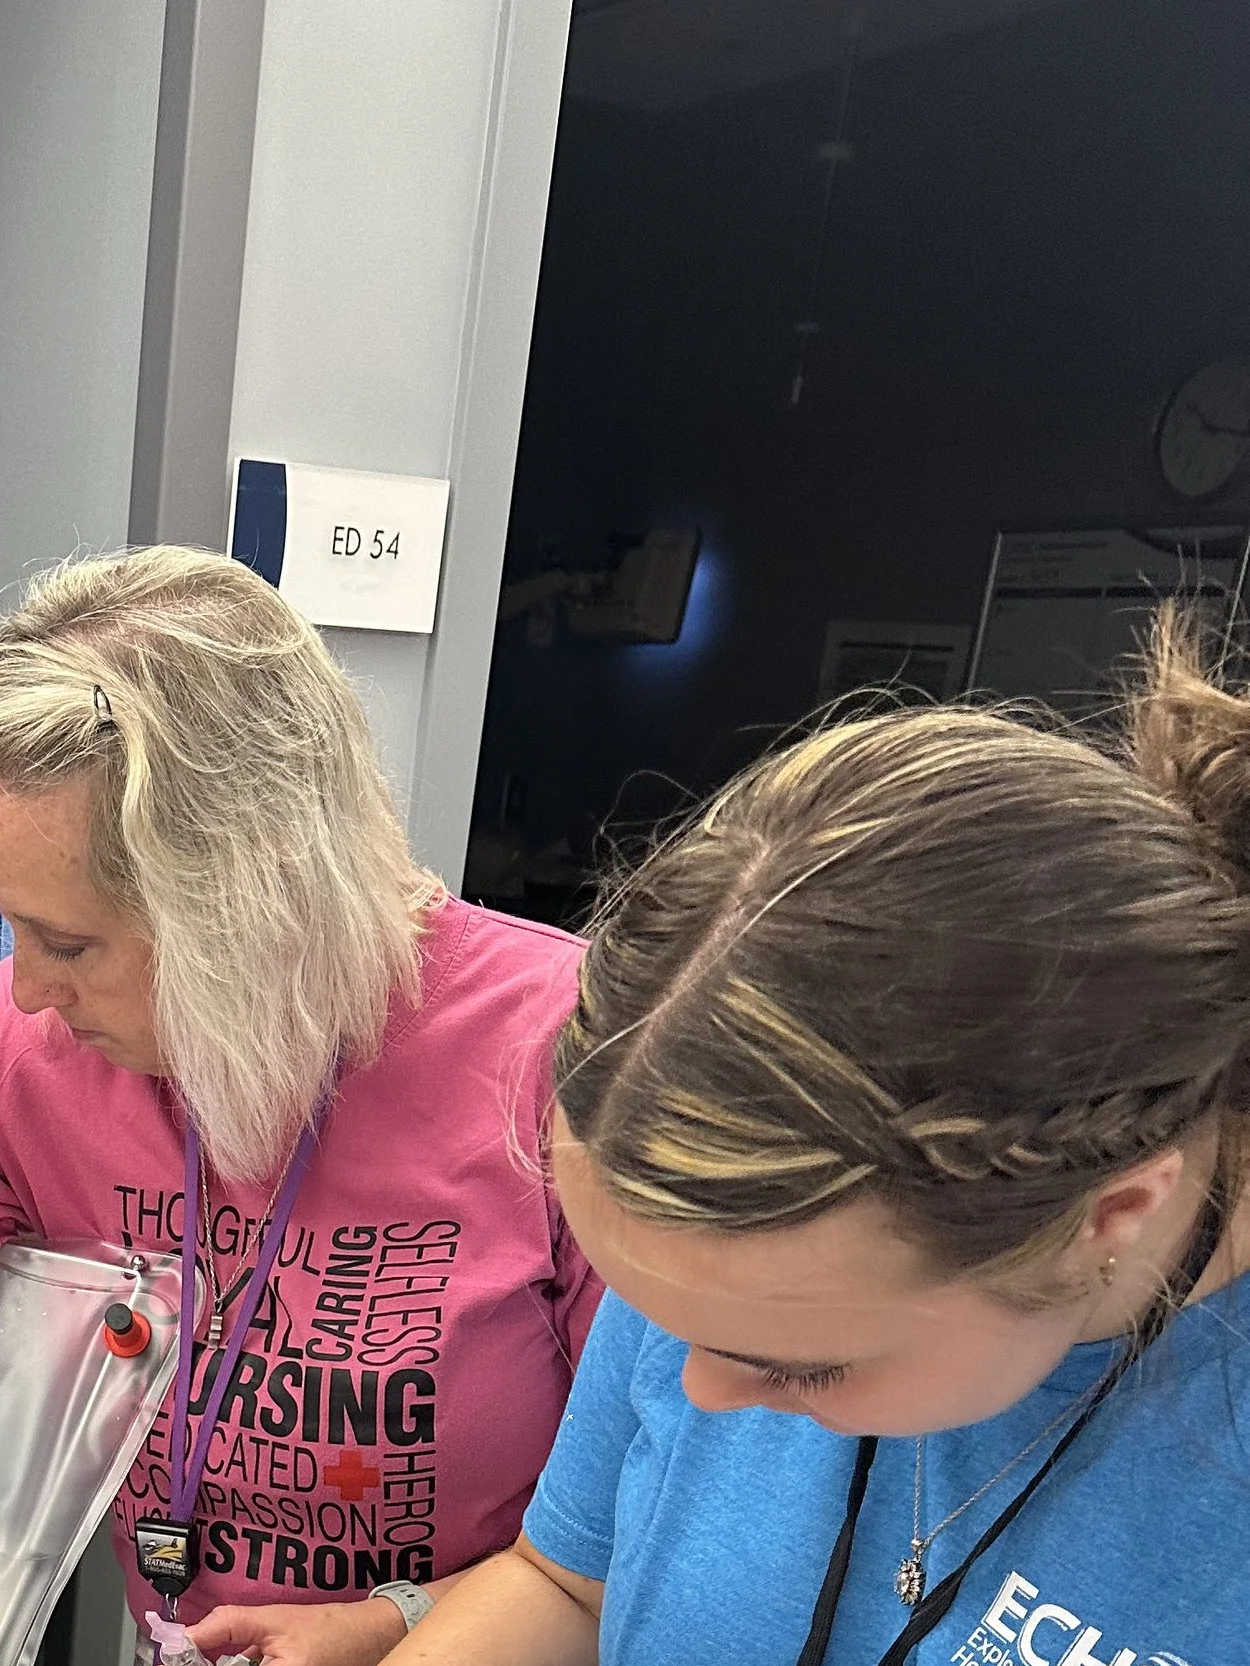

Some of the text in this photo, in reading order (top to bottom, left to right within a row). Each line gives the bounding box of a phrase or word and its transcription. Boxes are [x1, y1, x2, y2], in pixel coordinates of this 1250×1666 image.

[332, 525, 401, 560] ED 54
[305, 1225, 379, 1363] CARING
[356, 1220, 462, 1366] SELFLESS
[186, 1342, 436, 1446] URSING
[382, 1450, 437, 1546] HERO
[204, 1520, 435, 1591] STRONG
